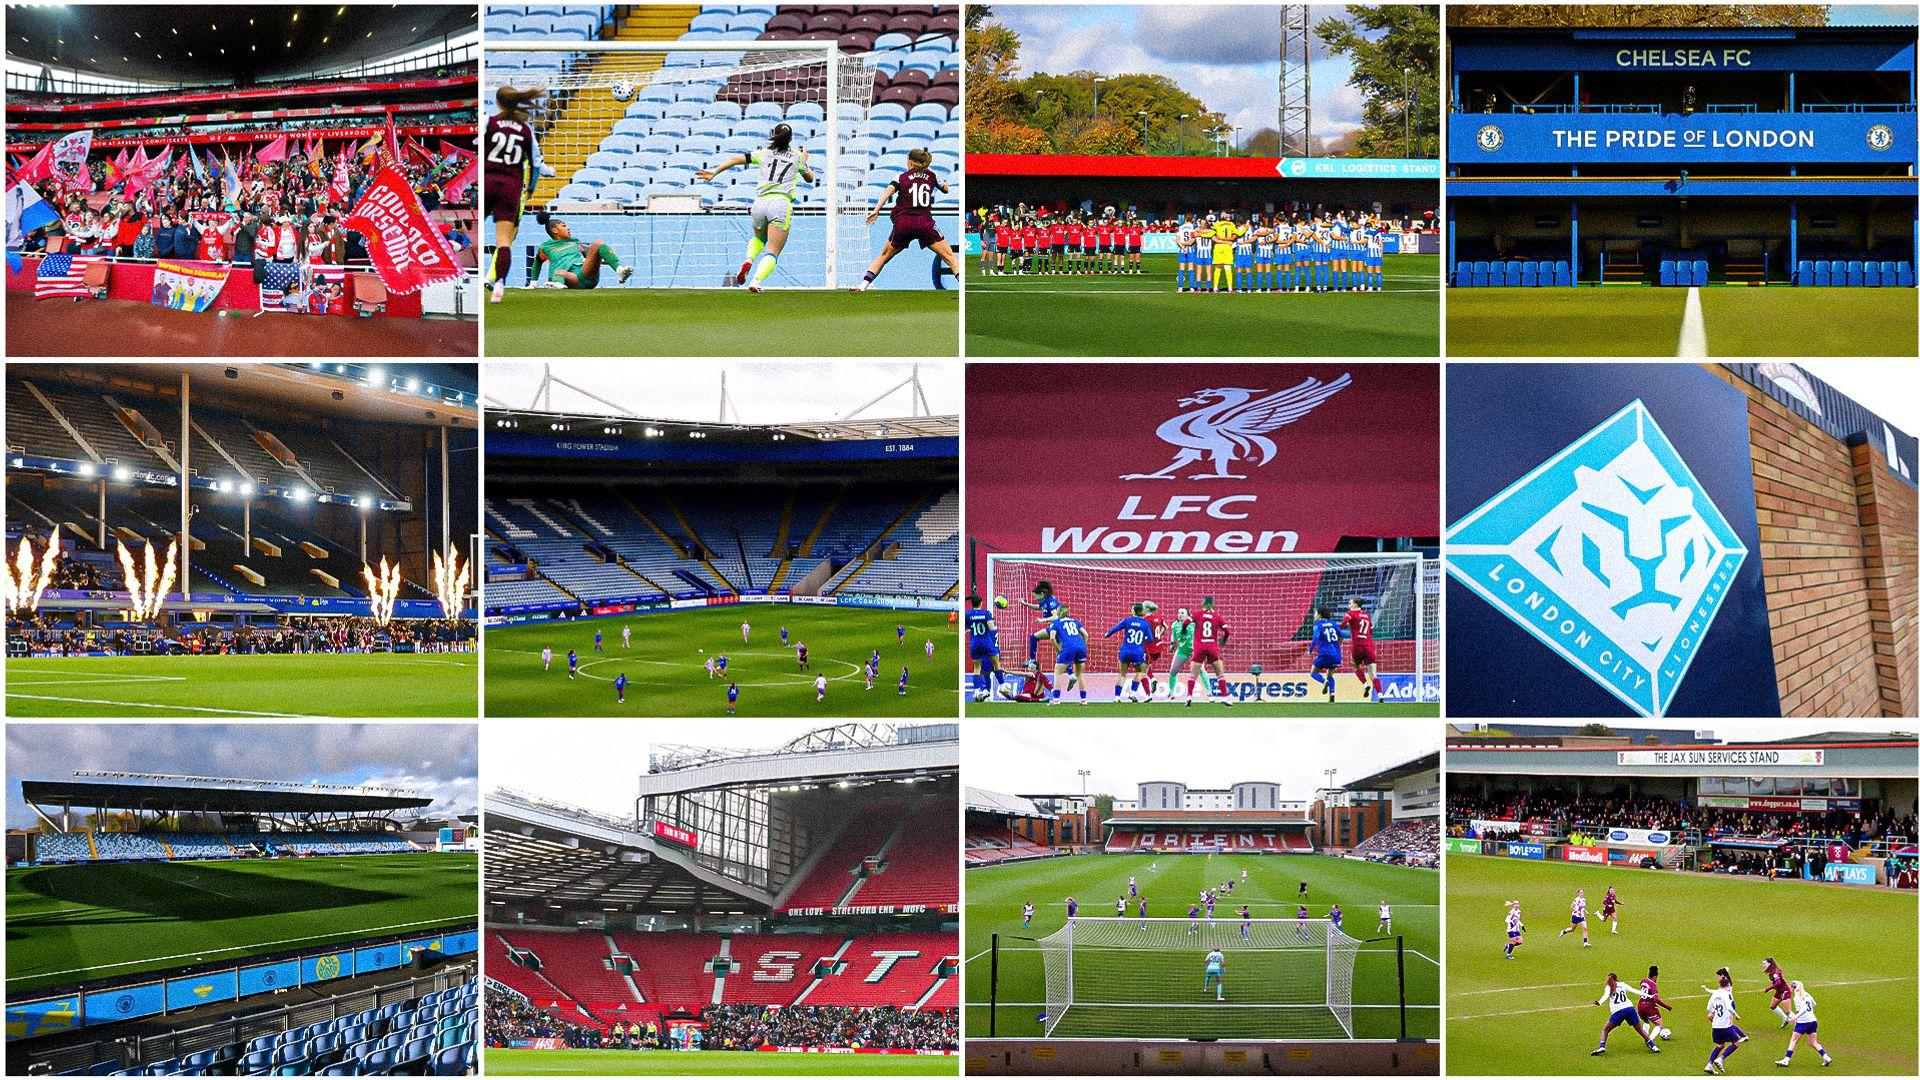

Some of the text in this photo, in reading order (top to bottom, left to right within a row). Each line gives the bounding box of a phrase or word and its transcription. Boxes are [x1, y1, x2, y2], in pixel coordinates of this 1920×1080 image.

[1616, 49, 1752, 67] CHELSEA FC
[328, 130, 369, 138] LIVERPOOL
[1553, 130, 1815, 148] THE PRIDE OF LONDON
[487, 131, 524, 165] 25
[767, 158, 794, 184] 17
[1315, 164, 1436, 173] KRL LOGISTICS STAND
[908, 182, 931, 207] 16
[355, 202, 416, 275] ARSENAL
[1117, 495, 1257, 520] LFC
[1041, 526, 1299, 553] Women
[1488, 563, 1646, 690] LONDON CITY
[1664, 560, 1733, 678] LIONESSES
[971, 622, 986, 636] 10
[1063, 621, 1080, 636] 18
[1127, 629, 1144, 646] 30
[1203, 621, 1212, 638] 8
[1324, 627, 1338, 642] 13
[1209, 678, 1308, 702] Express
[1654, 750, 1780, 764] THE JAX SUN SERVICES STAND
[1140, 833, 1277, 847] ORIENT
[789, 905, 894, 917] ONE LOVE STRETFORD END
